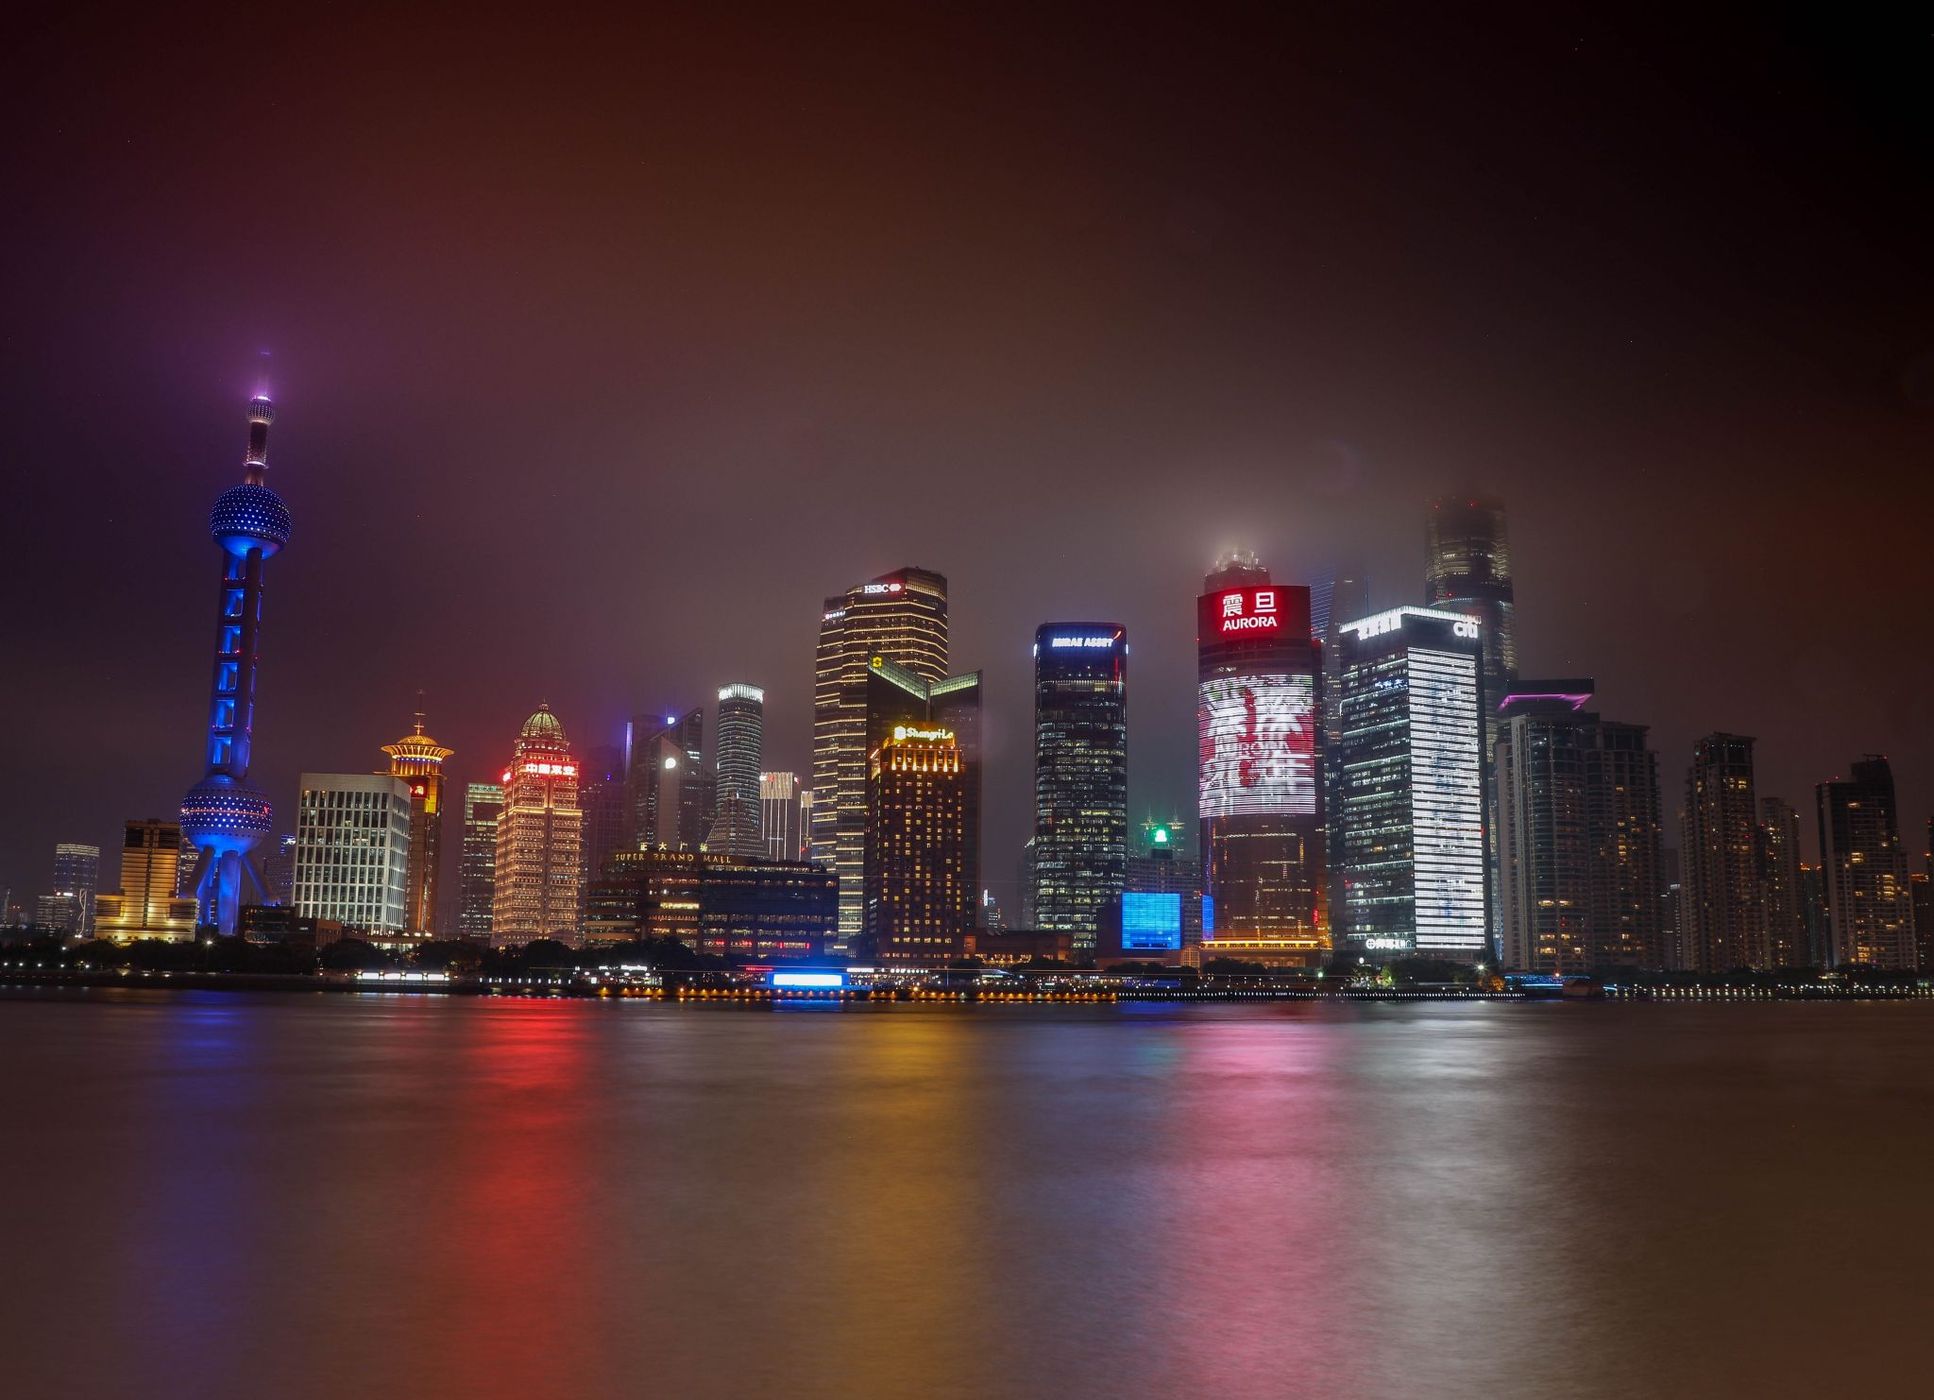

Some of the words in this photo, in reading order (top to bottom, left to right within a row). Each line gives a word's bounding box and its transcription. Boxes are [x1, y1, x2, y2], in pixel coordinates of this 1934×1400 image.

[864, 584, 889, 593] HSBC
[1223, 592, 1277, 617] 震旦
[1223, 616, 1277, 631] AURORA
[615, 853, 644, 861] SUPER
[653, 853, 694, 862] BRAND
[703, 855, 731, 864] MALL
